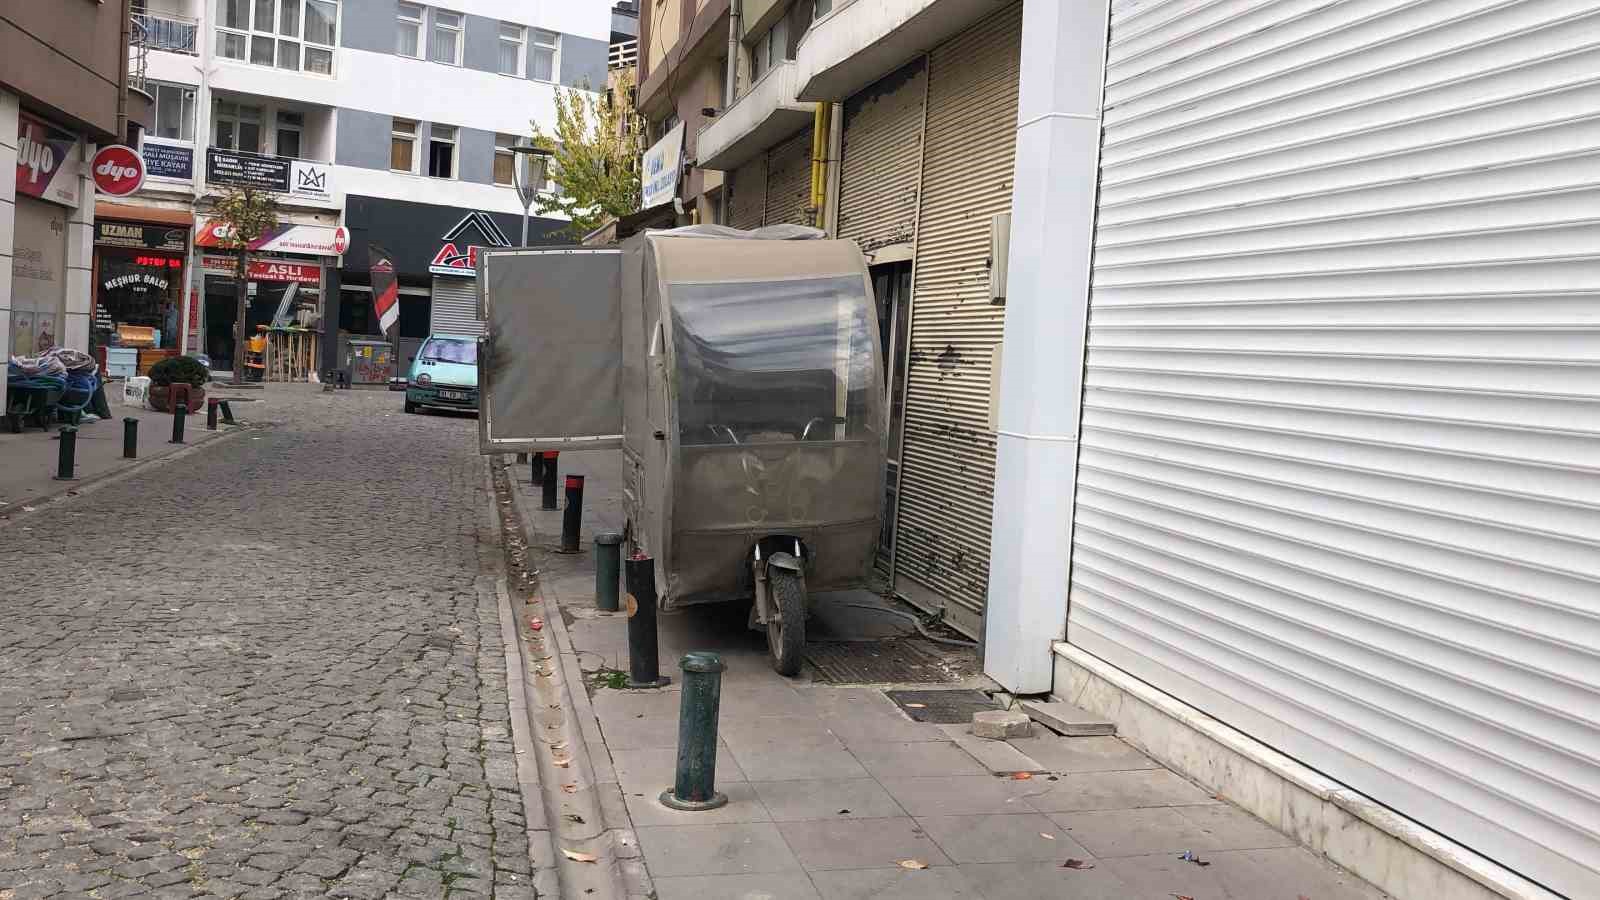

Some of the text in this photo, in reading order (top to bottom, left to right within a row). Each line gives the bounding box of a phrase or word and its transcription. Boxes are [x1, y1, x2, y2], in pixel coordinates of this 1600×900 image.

[17, 124, 53, 183] dyo
[96, 160, 138, 182] dyo
[161, 160, 186, 169] KAYAR
[101, 223, 143, 239] UZMAN
[268, 264, 303, 276] ASLI
[105, 274, 141, 290] MEŞHUR
